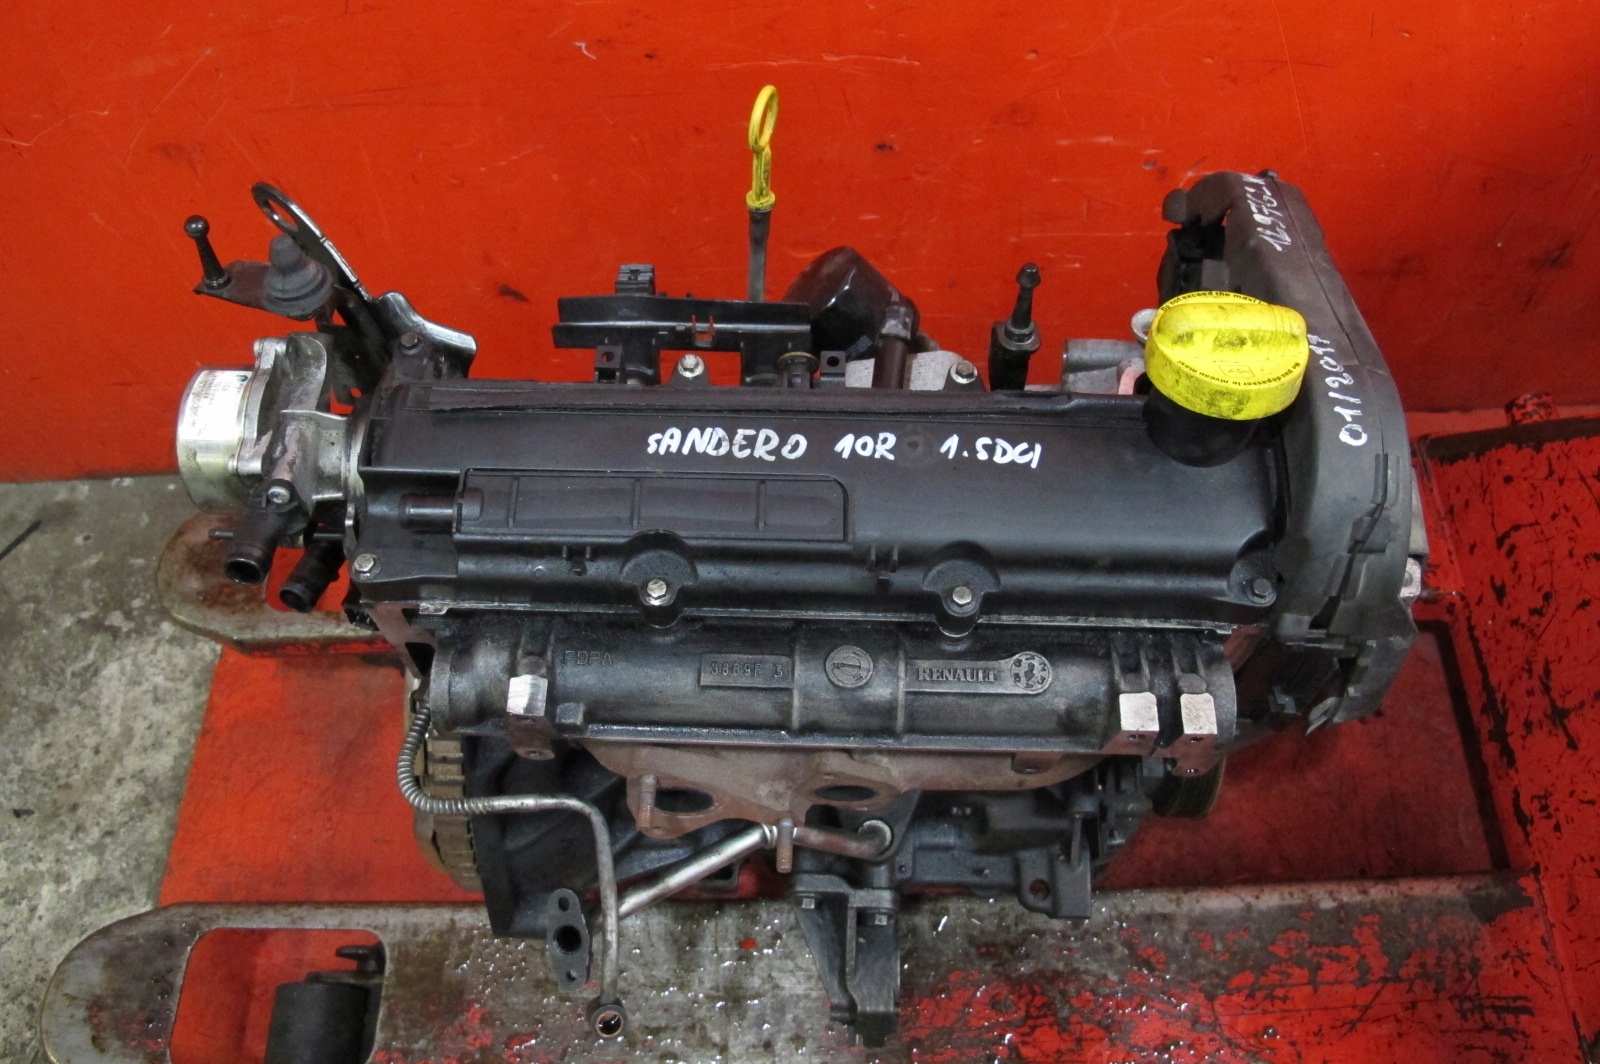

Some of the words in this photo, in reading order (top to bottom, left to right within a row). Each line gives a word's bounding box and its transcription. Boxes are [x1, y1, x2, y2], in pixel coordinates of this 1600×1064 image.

[1170, 297, 1181, 305] not
[1182, 291, 1213, 300] exceed
[1233, 294, 1257, 303] maxi
[1177, 360, 1198, 373] maxi
[1291, 361, 1301, 370] Ne
[1199, 372, 1229, 384] niveau
[1281, 369, 1293, 378] pas
[646, 427, 808, 462] SANDERO
[833, 432, 897, 461] 10R
[917, 667, 999, 683] RENAULT
